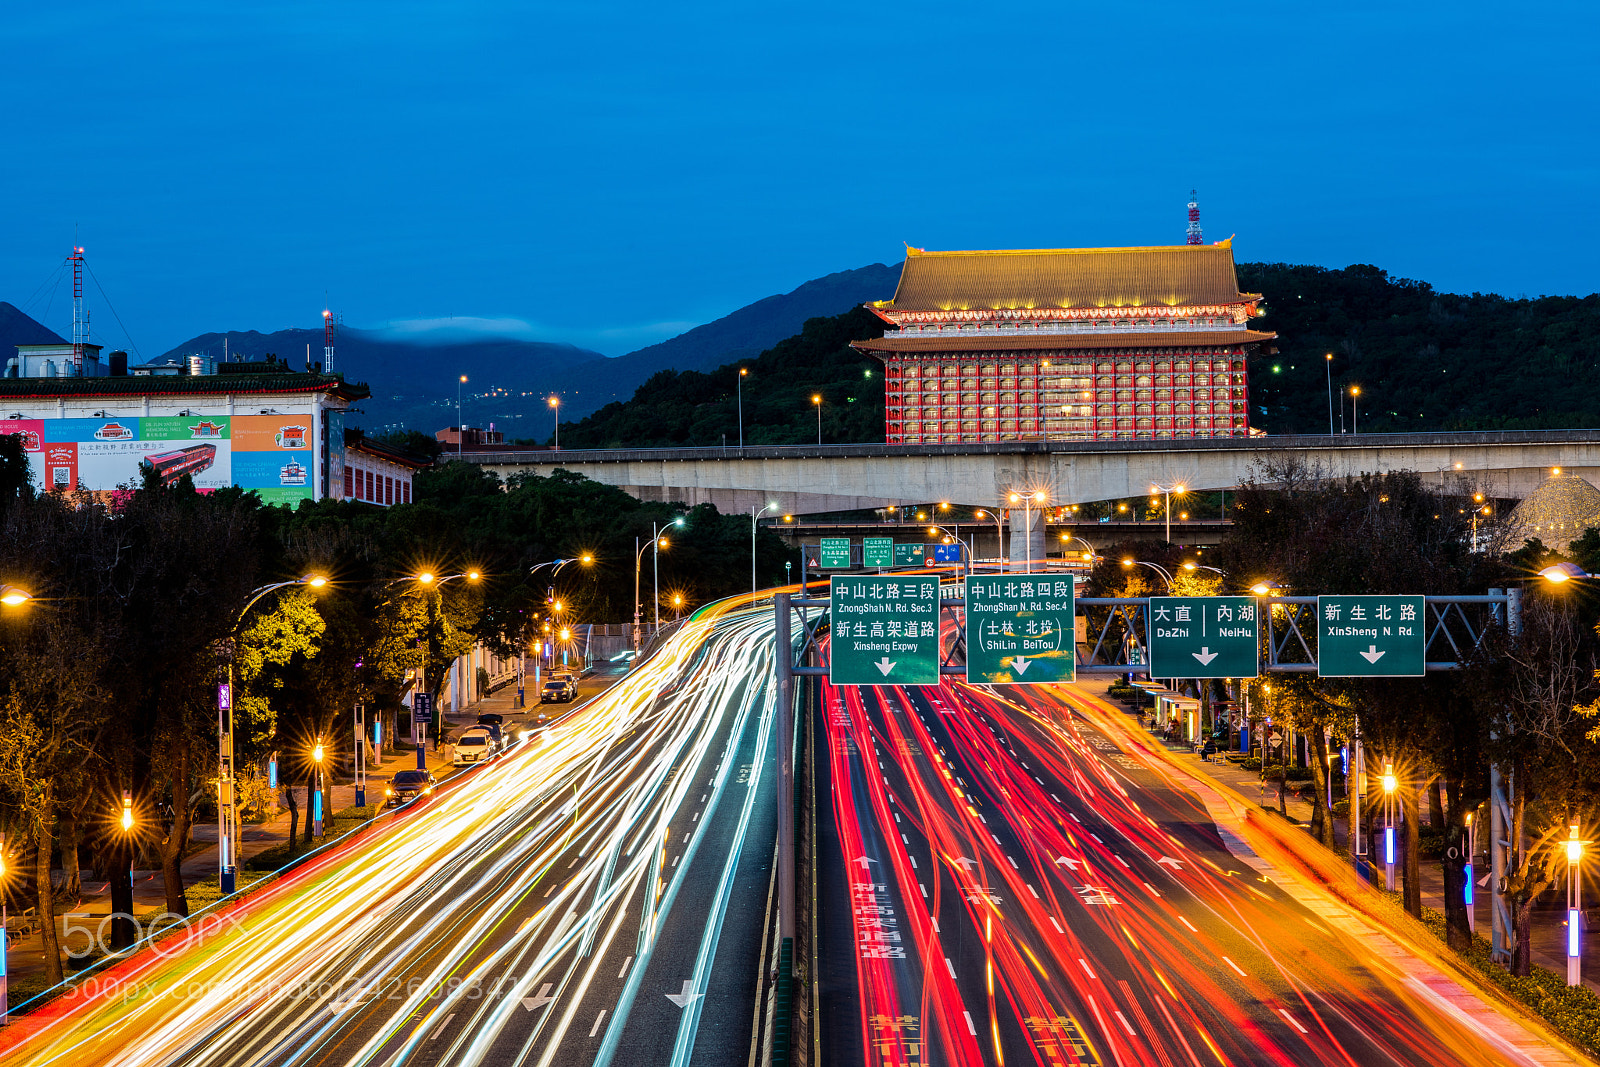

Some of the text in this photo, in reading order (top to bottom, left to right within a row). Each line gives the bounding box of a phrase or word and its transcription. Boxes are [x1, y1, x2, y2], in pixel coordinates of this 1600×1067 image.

[836, 583, 935, 600] 中山北路三段
[971, 581, 1068, 600] 中山北路四段
[895, 603, 909, 613] Rd.
[911, 603, 932, 613] Sec.3
[973, 602, 1018, 614] ZhongShan
[1030, 602, 1044, 611] Rd.
[1045, 601, 1067, 611] Sec.4
[1154, 604, 1192, 622] 大直
[1325, 603, 1417, 621] 新生北路
[836, 620, 936, 638] 新生高架道路
[1157, 628, 1189, 638] DaZhi
[1219, 627, 1252, 638] NeiHu
[1327, 626, 1378, 639] XinSheng
[1398, 626, 1415, 636] Rd.
[853, 641, 918, 653] Xinsheng Expwy
[986, 639, 1054, 650] ShiLin BeiTou
